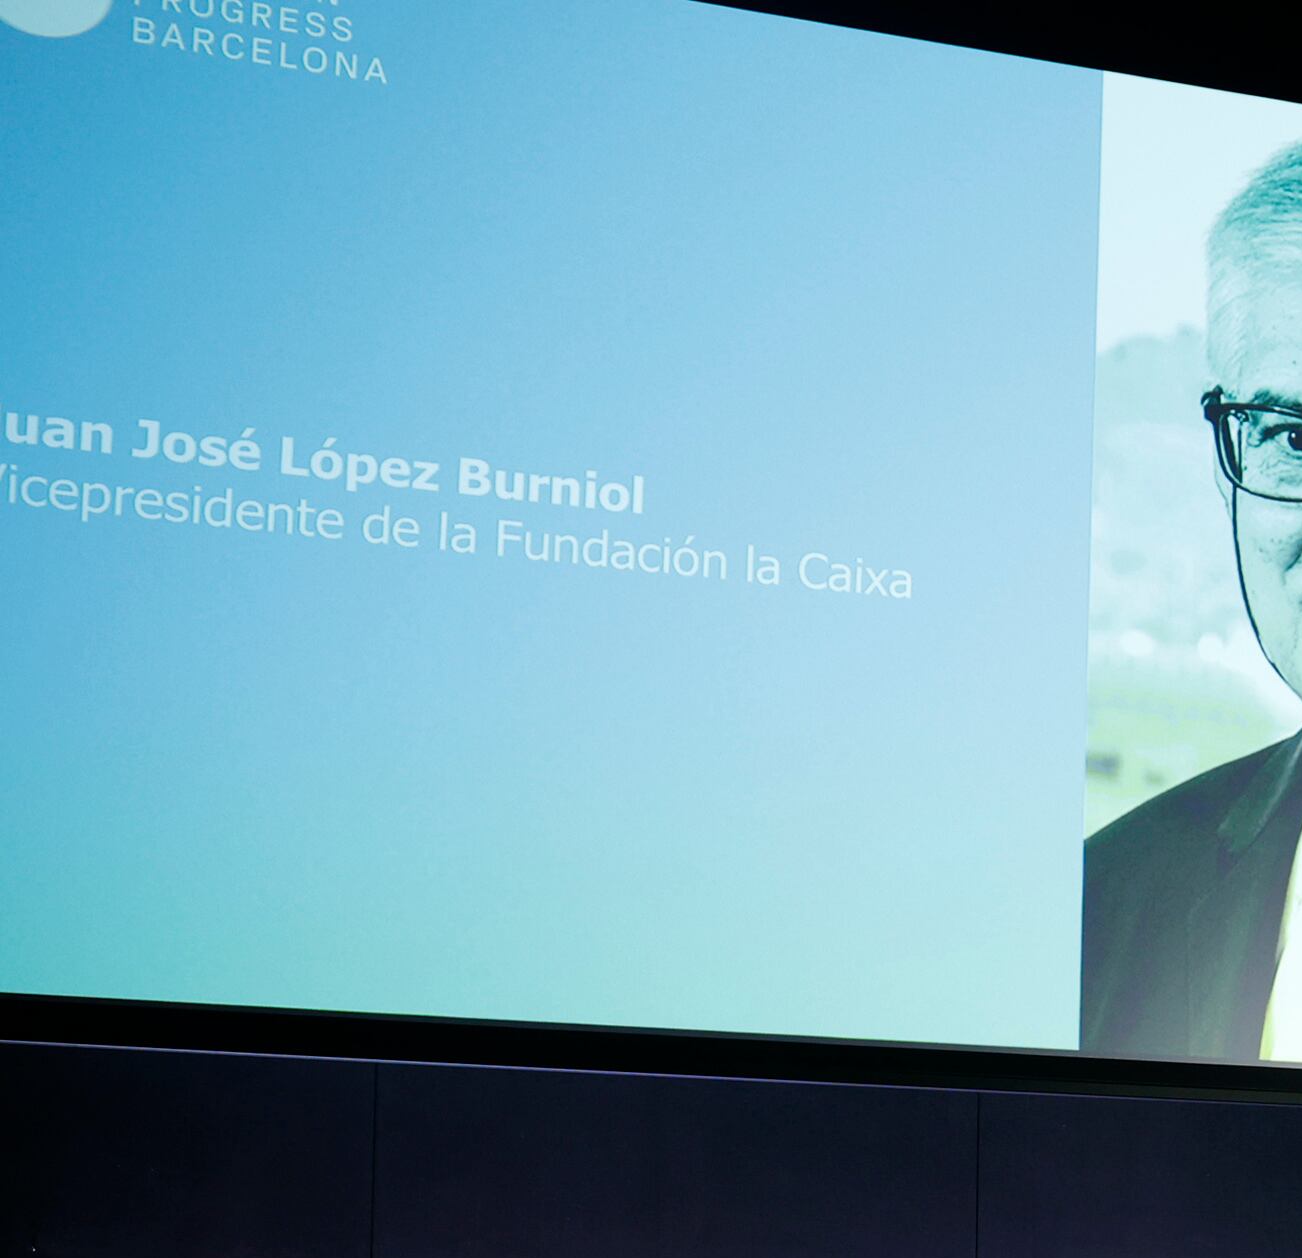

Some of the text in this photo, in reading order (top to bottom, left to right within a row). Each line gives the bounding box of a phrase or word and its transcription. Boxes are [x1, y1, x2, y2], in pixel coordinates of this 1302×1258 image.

[132, 16, 387, 84] BARCELONA
[0, 411, 643, 514] uan José López Burniol
[0, 463, 913, 600] icepresidente de la Fundación la Caixa
